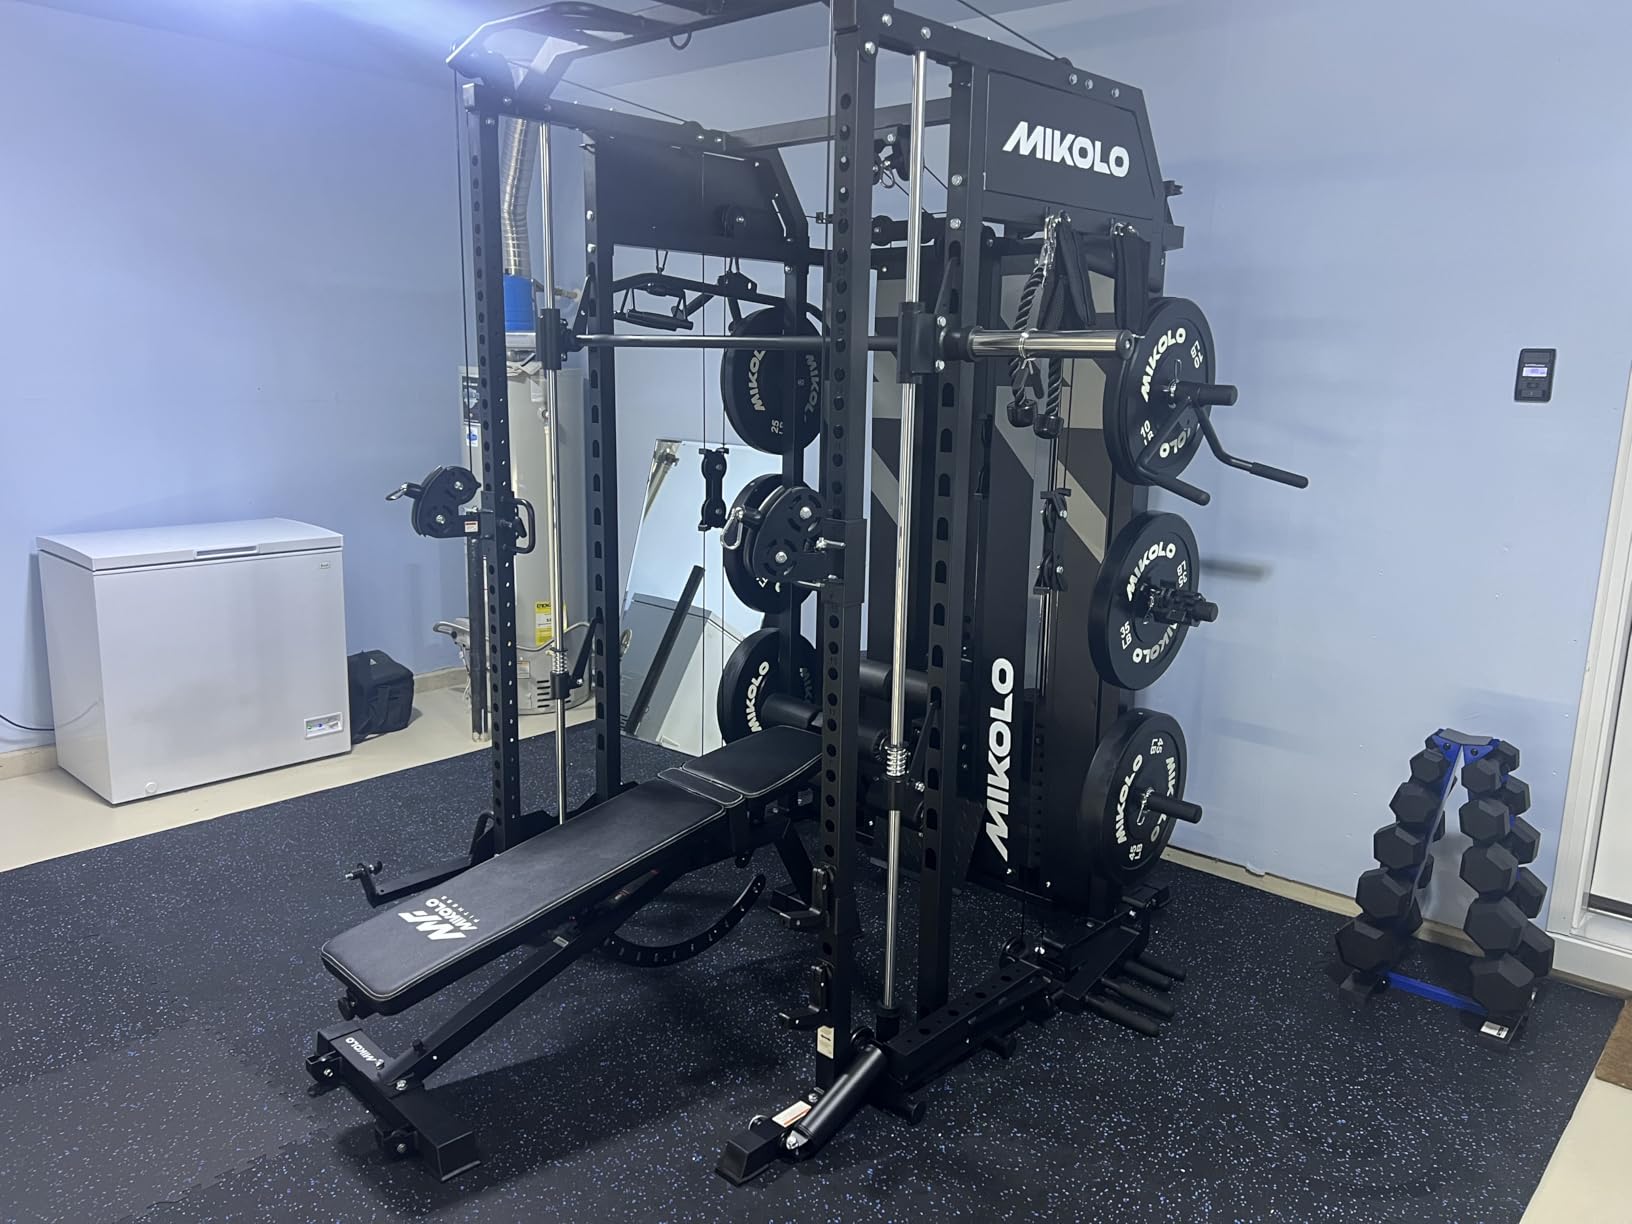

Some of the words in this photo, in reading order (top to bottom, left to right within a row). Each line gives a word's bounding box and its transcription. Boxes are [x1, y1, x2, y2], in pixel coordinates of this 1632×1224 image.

[1002, 121, 1130, 178] MIKOLO
[748, 350, 767, 412] MIKOL
[1141, 327, 1187, 403] MIKOLO
[771, 419, 780, 433] 25
[1140, 420, 1151, 438] 10
[1126, 541, 1177, 602] MIKOLO
[1119, 620, 1131, 639] 35
[1121, 634, 1133, 650] LB
[745, 660, 770, 733] MIKOLO
[986, 657, 1015, 862] MIKOLO
[1115, 754, 1143, 844] MIKOLO
[1150, 756, 1177, 842] MIKLO
[425, 898, 479, 931] MIKOLO
[345, 1037, 377, 1062] MIKOLO
